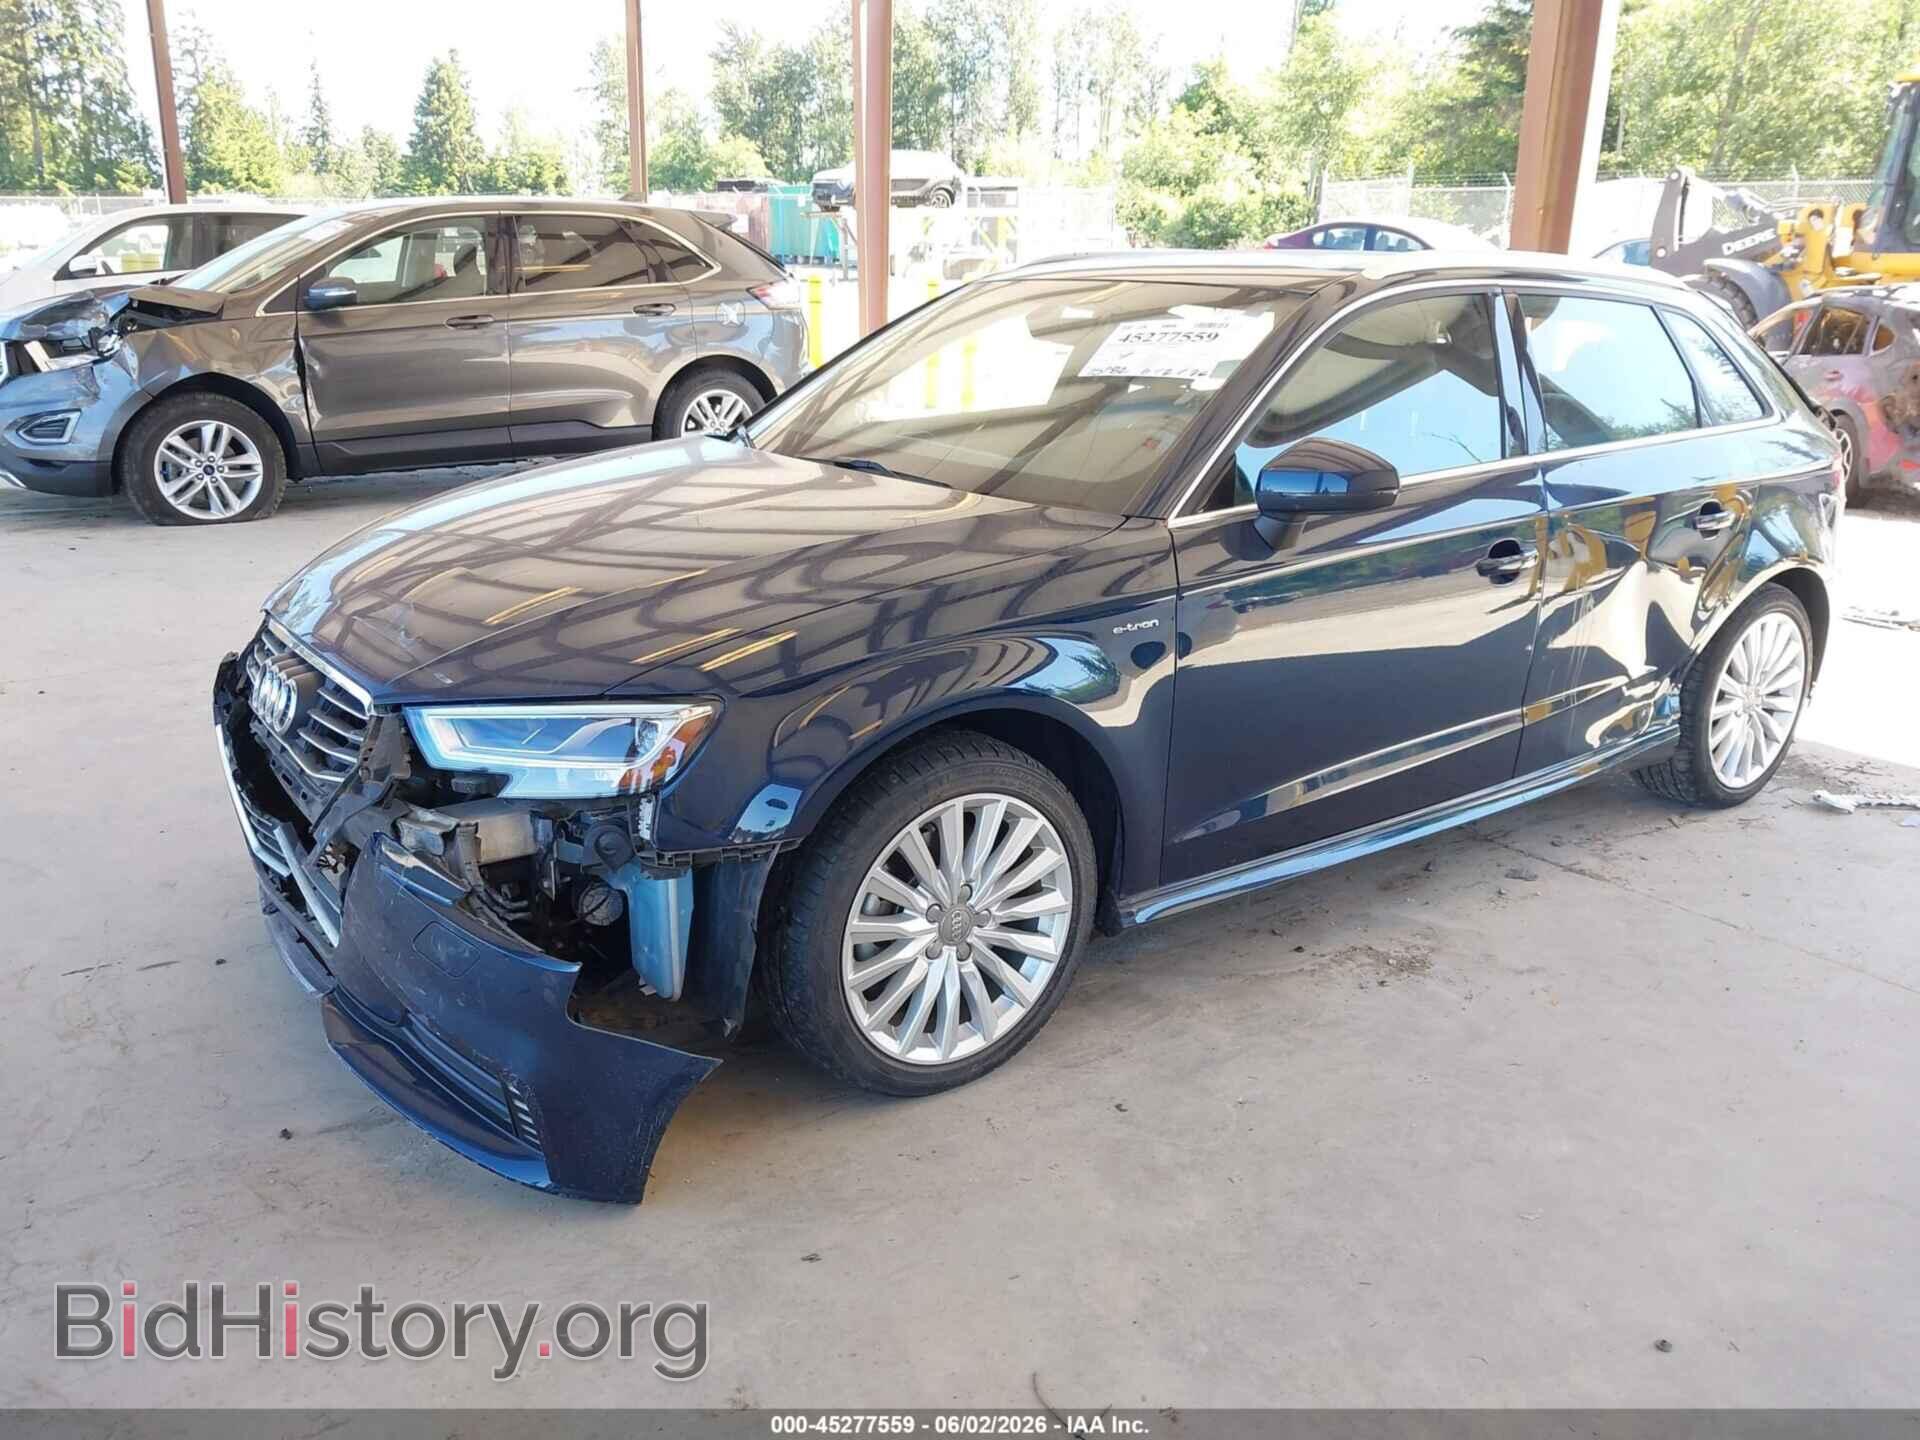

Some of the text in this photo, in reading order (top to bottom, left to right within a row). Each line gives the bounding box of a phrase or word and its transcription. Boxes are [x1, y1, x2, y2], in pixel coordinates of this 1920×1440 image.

[1722, 228, 1776, 256] DEERE
[1118, 331, 1220, 344] 45277559
[1112, 618, 1159, 634] e-tron
